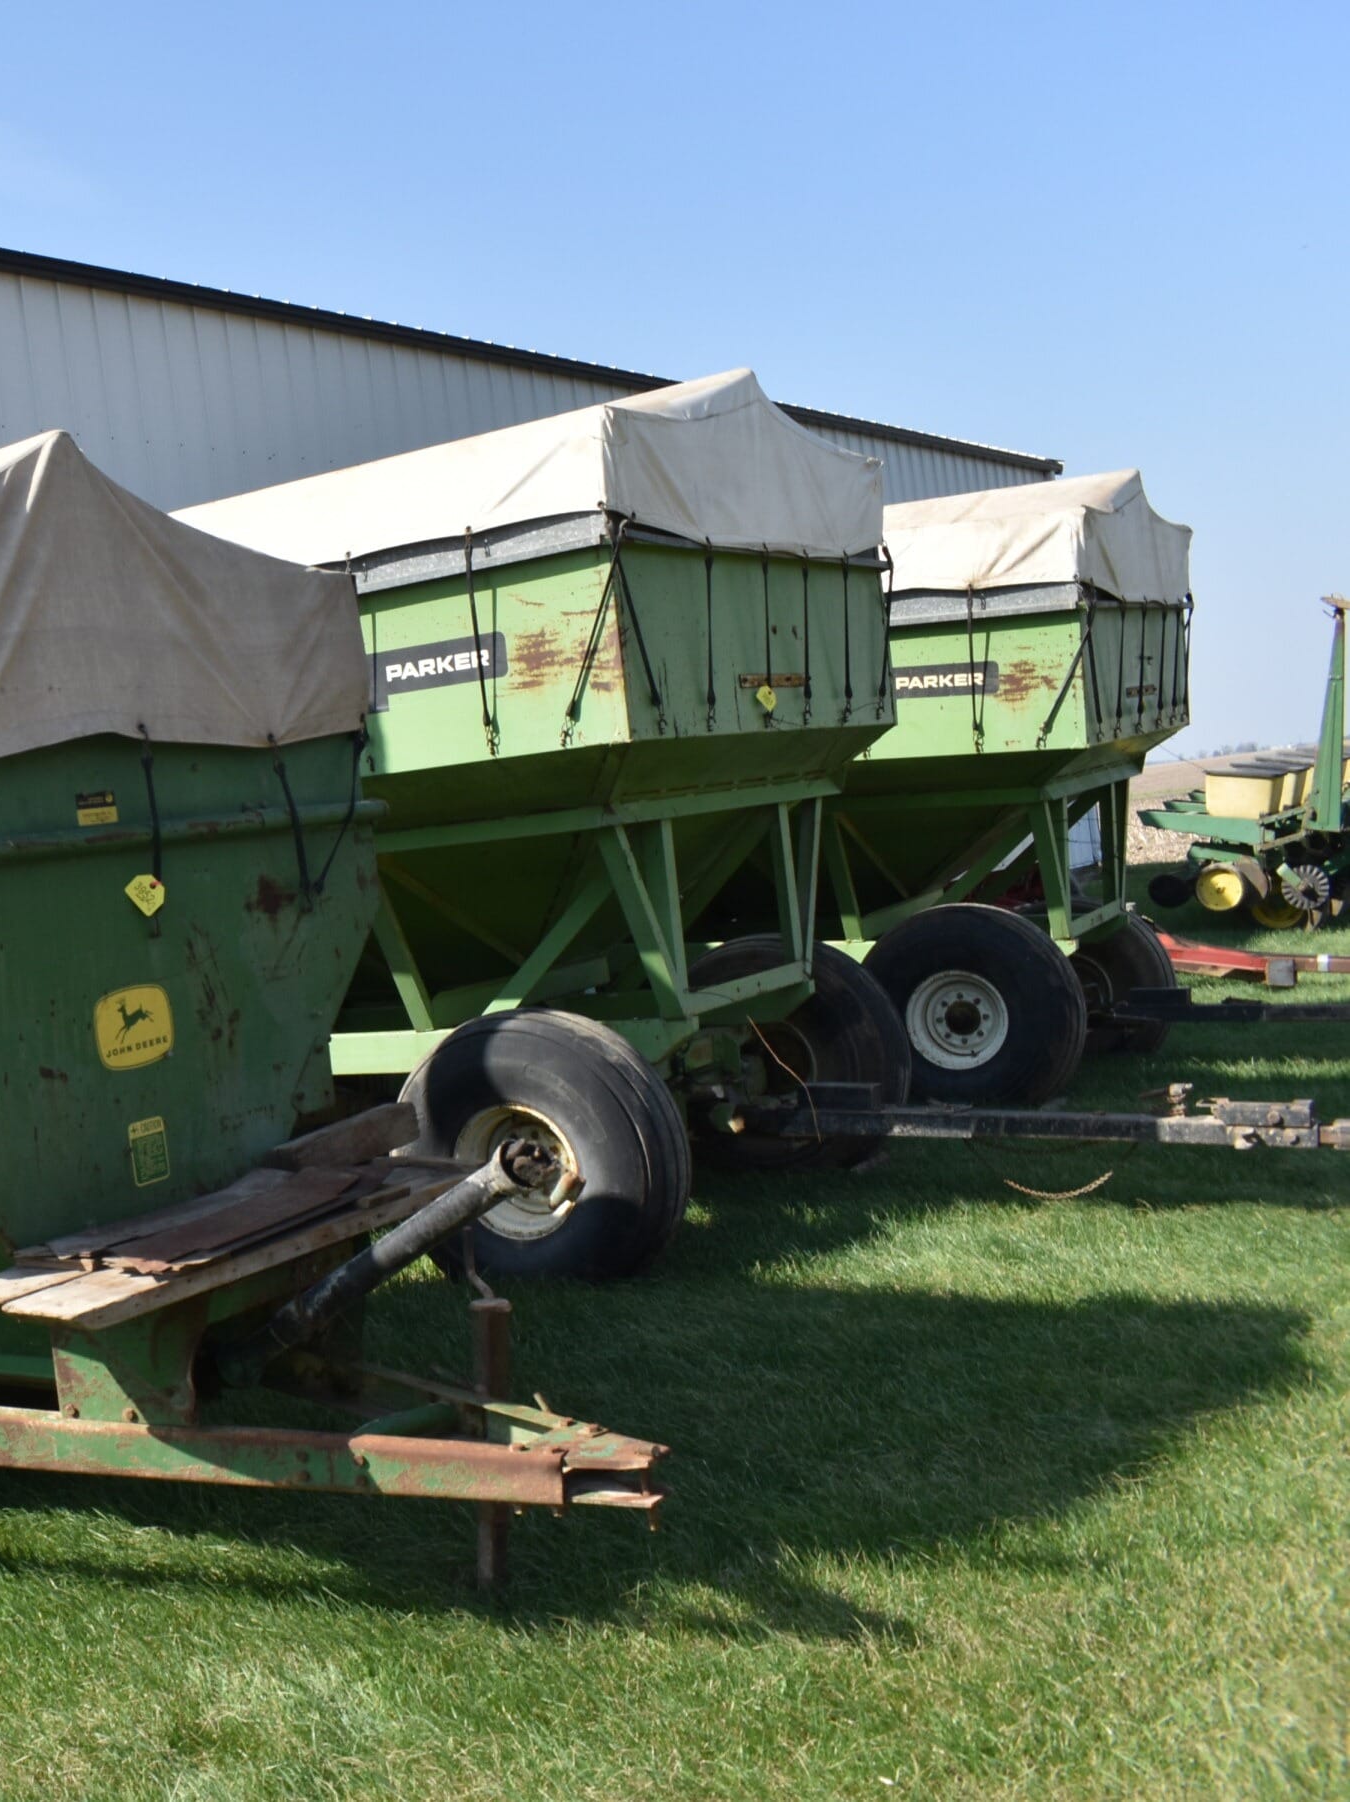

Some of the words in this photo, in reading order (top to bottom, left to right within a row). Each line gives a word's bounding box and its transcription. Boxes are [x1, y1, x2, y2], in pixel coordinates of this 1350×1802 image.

[385, 649, 490, 682] PARKER
[895, 672, 984, 690] PARKER
[105, 1046, 133, 1059] JOHN
[135, 1035, 169, 1051] DEERE
